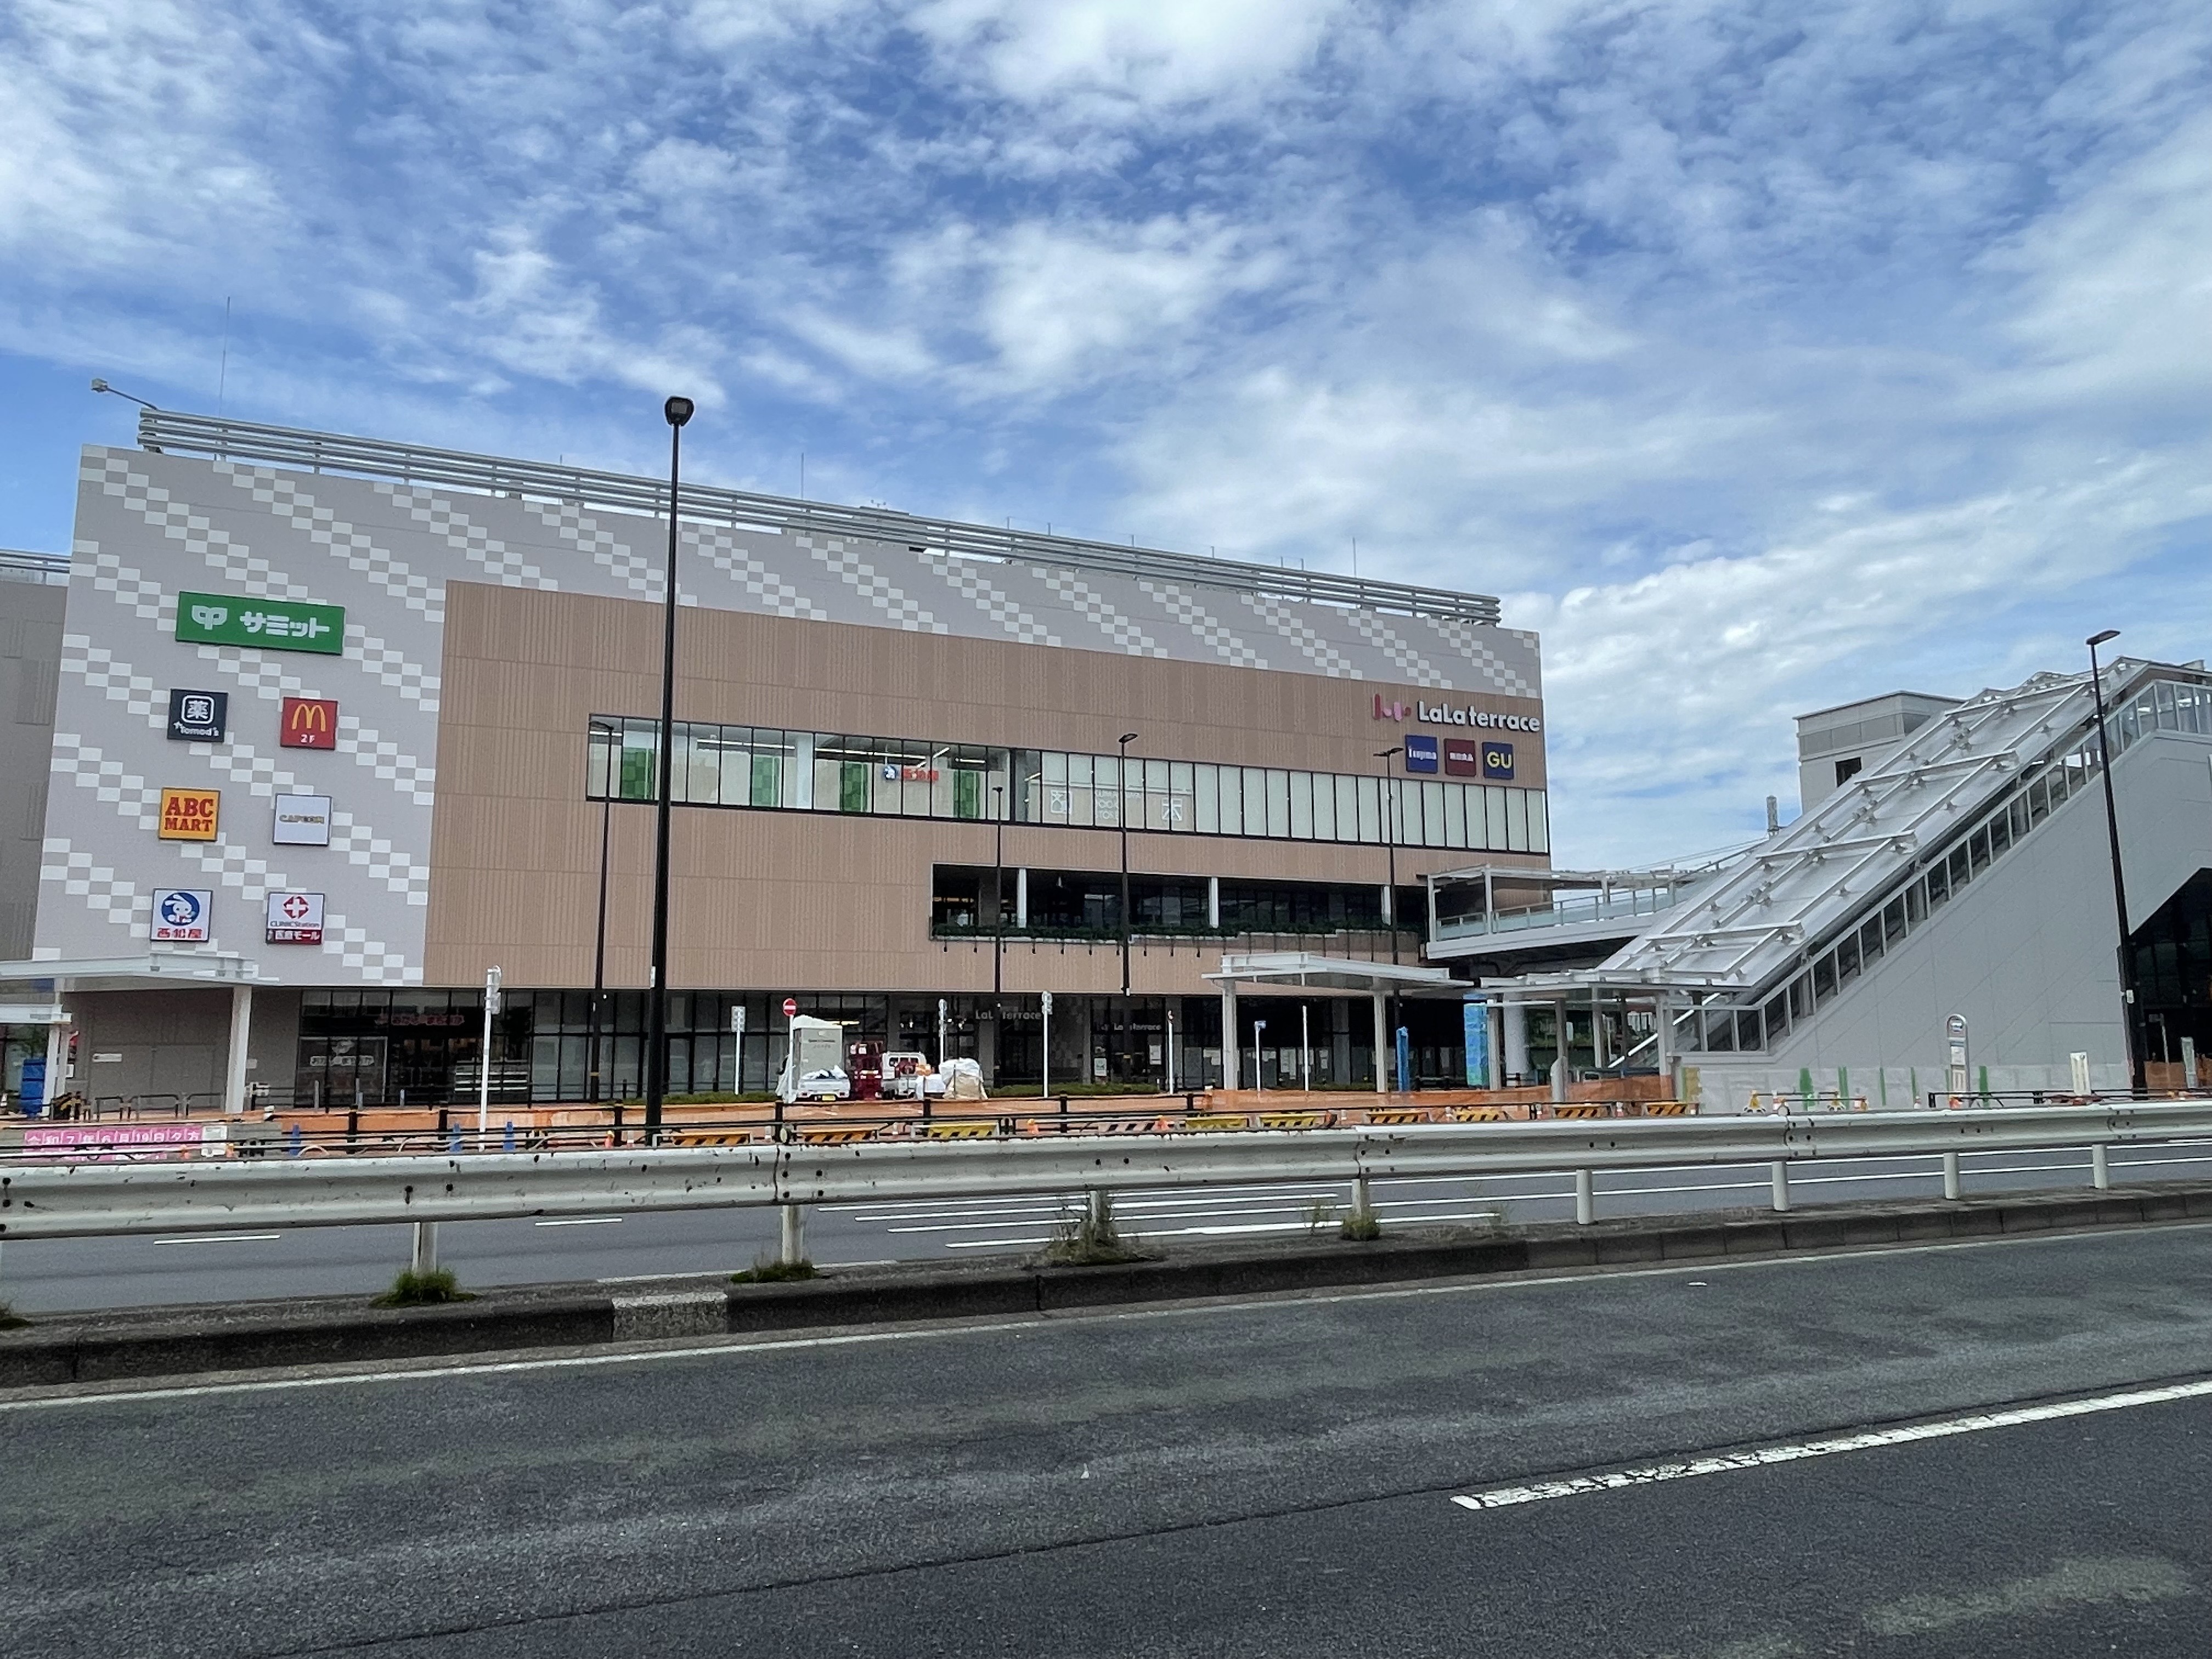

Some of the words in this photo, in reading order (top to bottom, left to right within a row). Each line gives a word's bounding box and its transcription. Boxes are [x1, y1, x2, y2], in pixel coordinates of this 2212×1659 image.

[240, 611, 330, 639] サミット
[1417, 700, 1466, 725] LaLa
[1467, 705, 1541, 732] terrace
[300, 734, 315, 743] 2F
[1487, 751, 1512, 769] GU
[165, 797, 214, 817] ABC
[165, 818, 213, 832] MART
